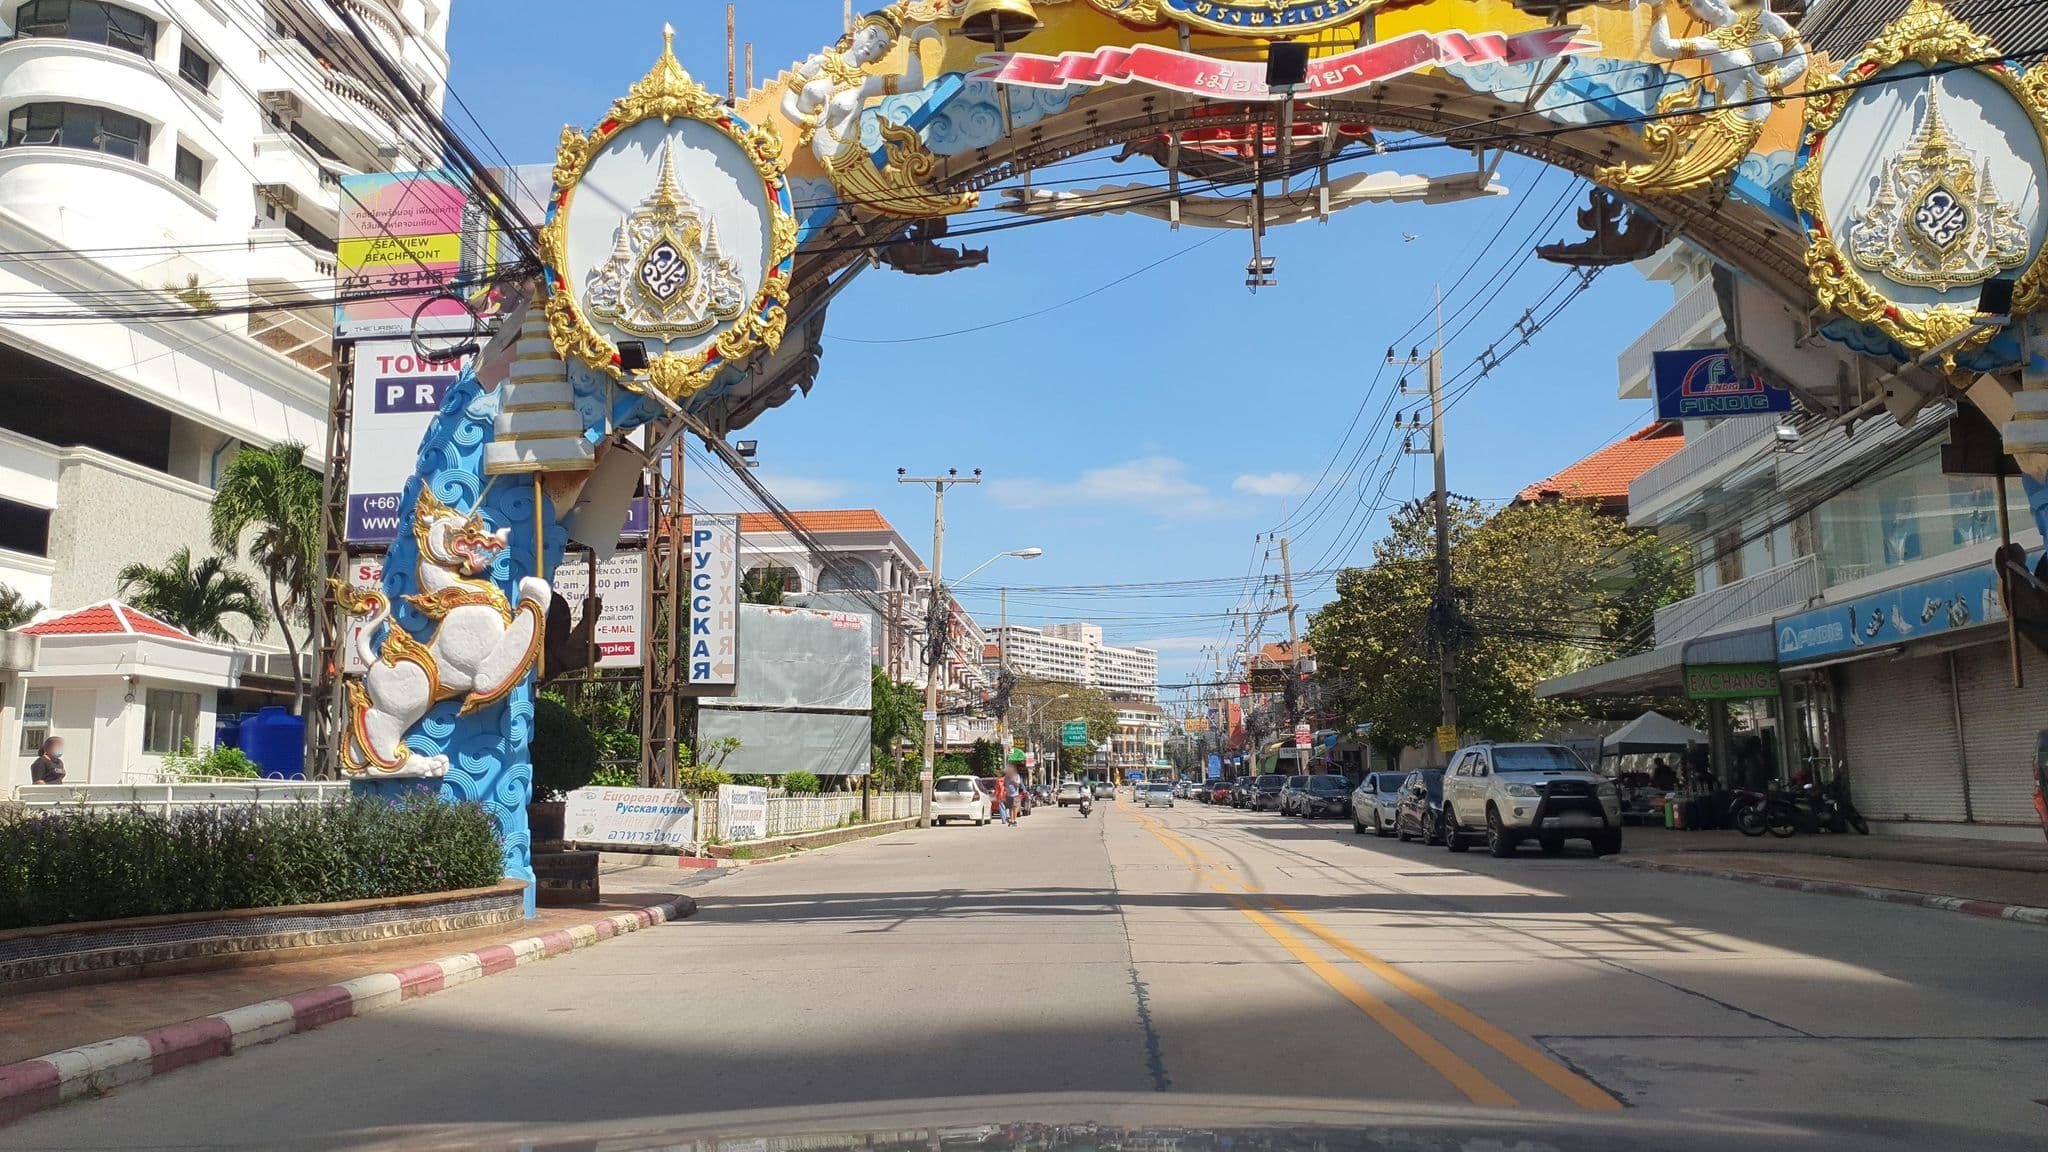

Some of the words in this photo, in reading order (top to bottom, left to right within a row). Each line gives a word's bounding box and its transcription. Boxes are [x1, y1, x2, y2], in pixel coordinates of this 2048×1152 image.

[374, 239, 396, 249] SEA
[398, 238, 429, 248] VIEW
[365, 250, 440, 262] BEACHFRONT
[388, 272, 409, 287] 38
[1680, 395, 1769, 413] FINDIG
[563, 582, 579, 590] am
[613, 580, 630, 590] pm
[718, 535, 733, 656] КУХНЯ
[604, 604, 634, 613] 251363
[692, 529, 713, 680] РУССКАЯ
[601, 625, 635, 634] E-MAIL
[1798, 622, 1844, 649] FINDIG
[1252, 673, 1288, 686] OSCA
[1689, 671, 1778, 692] EXCHANGE
[602, 790, 660, 804] European
[615, 802, 658, 815] Русская
[659, 805, 691, 817] кухня
[607, 828, 682, 843] อาหารไทย
